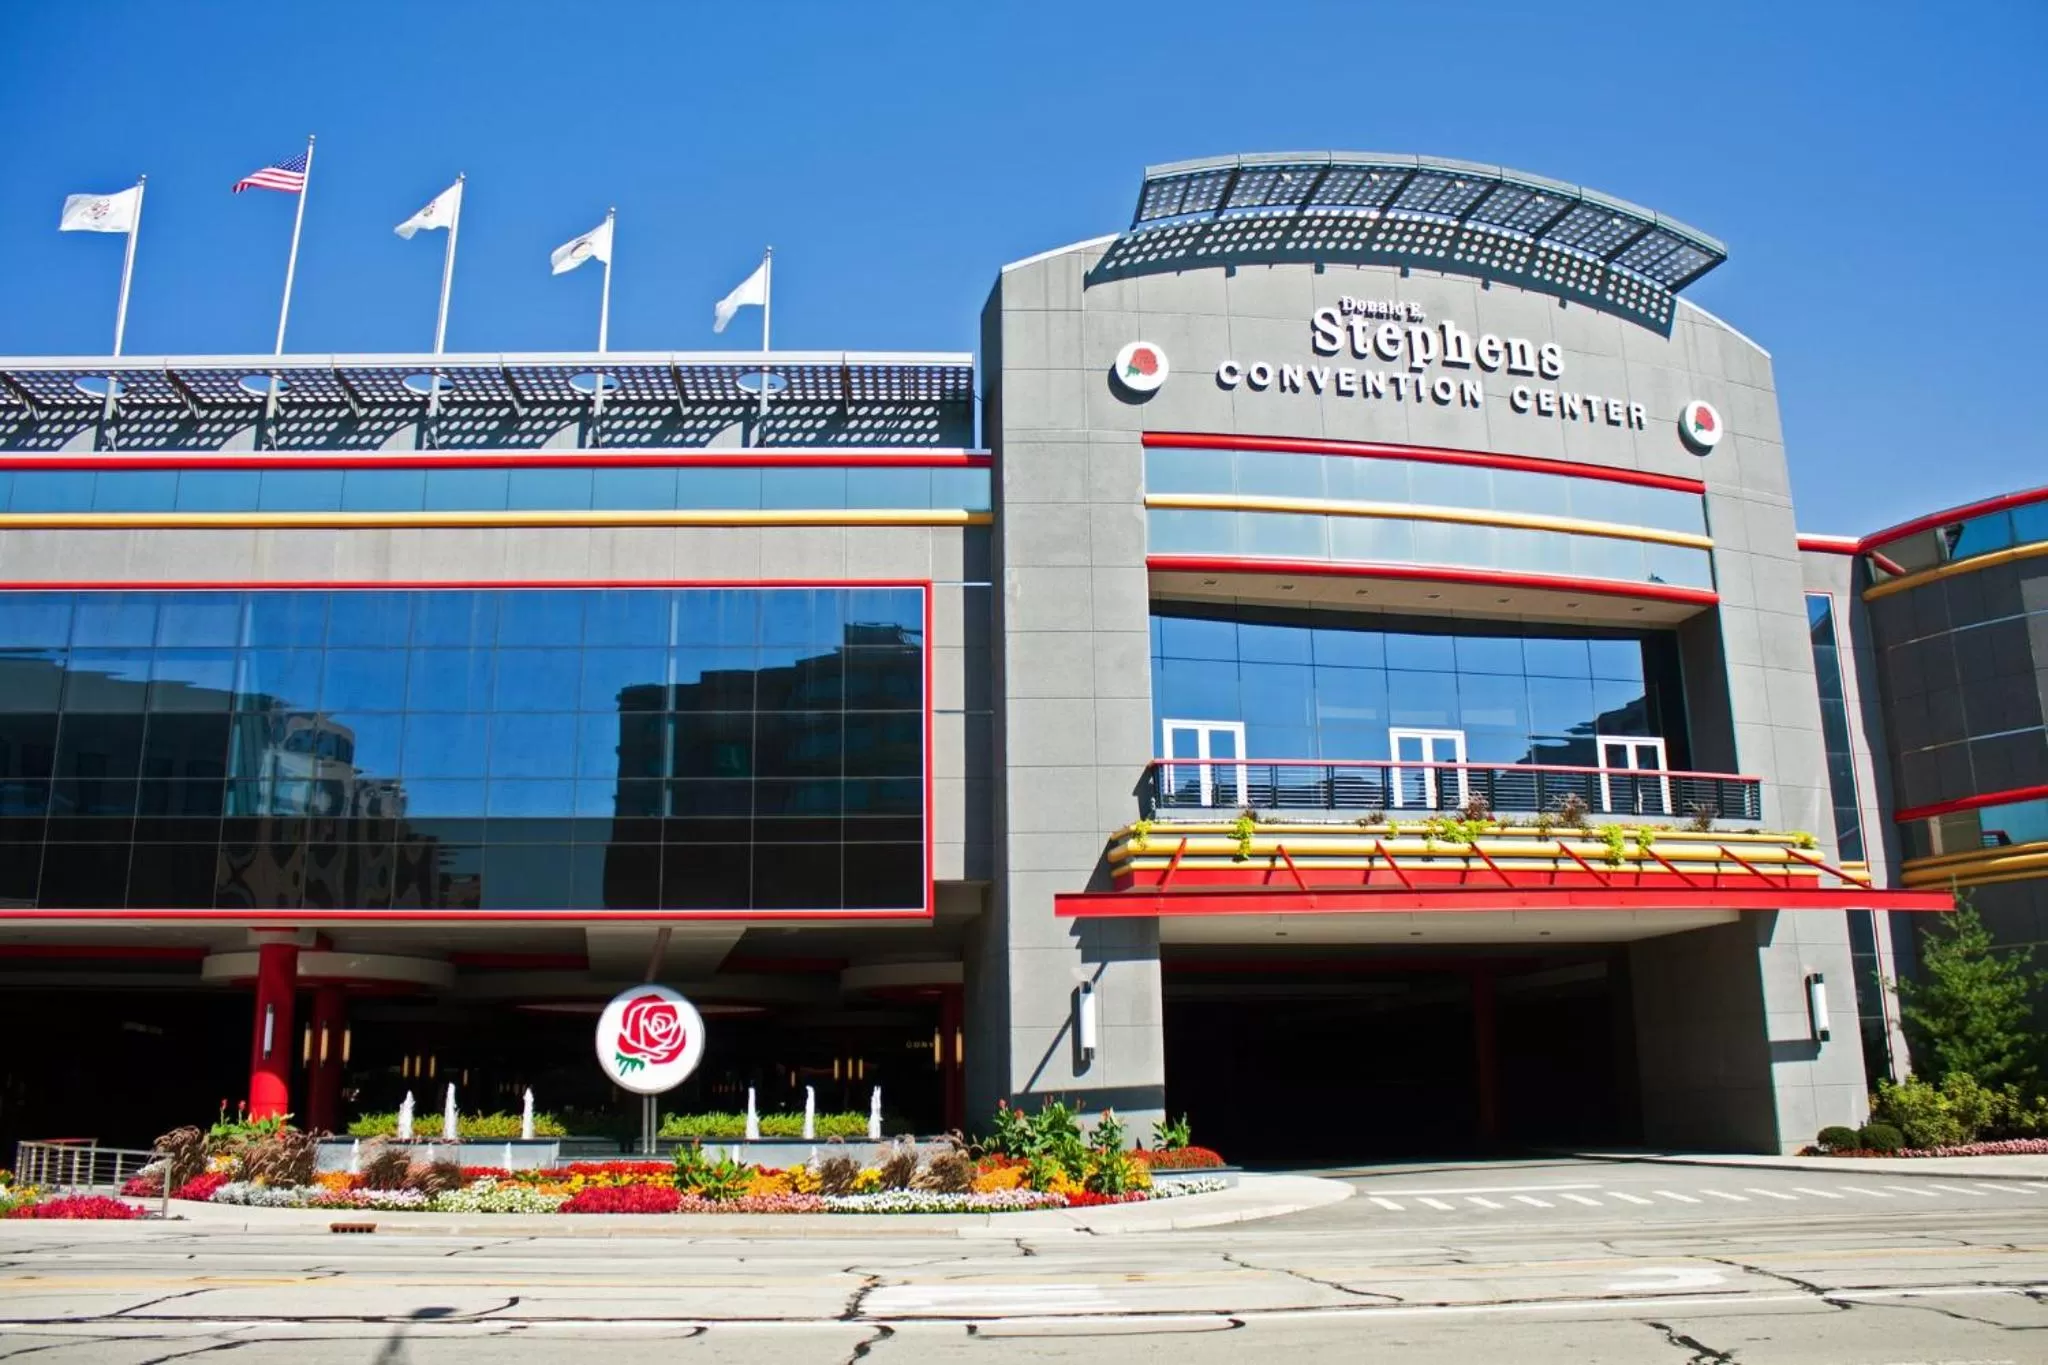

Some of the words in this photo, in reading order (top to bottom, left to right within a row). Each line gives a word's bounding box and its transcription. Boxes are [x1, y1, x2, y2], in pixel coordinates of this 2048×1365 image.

[1341, 295, 1404, 317] Donald
[1312, 307, 1565, 379] Stephens
[1218, 360, 1483, 407] CONVENTION
[1512, 384, 1648, 427] CENTER
